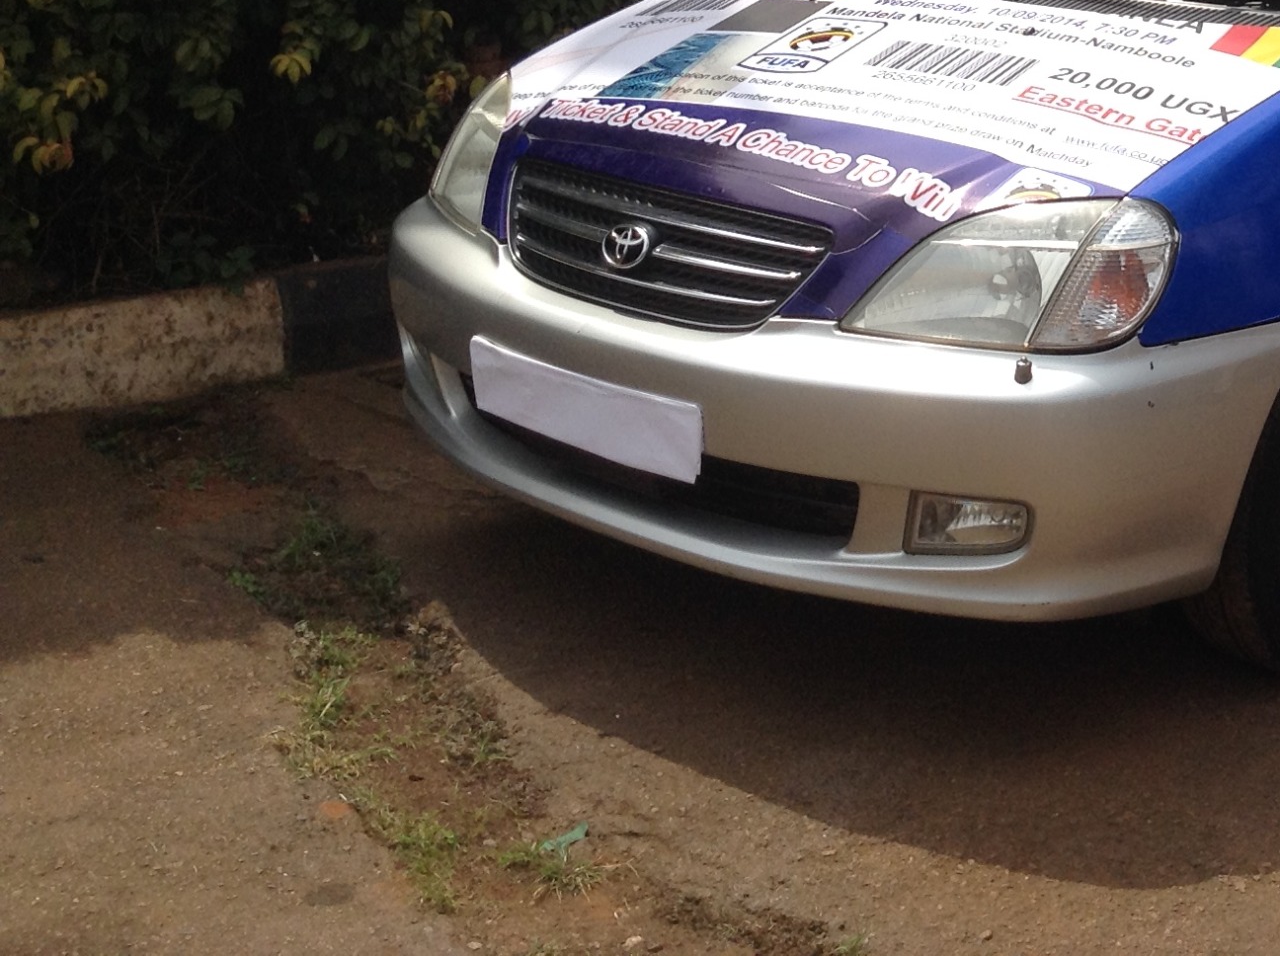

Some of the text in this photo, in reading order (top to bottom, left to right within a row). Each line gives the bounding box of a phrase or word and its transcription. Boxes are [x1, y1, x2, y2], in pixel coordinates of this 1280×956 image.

[825, 6, 904, 22] Mandela
[907, 12, 992, 30] National
[1094, 23, 1139, 39] 7:30
[1140, 32, 1178, 46] PM
[756, 56, 811, 69] FUFA
[1015, 85, 1136, 126] Eastern
[1048, 67, 1240, 123] 20,000 UGX
[540, 97, 623, 125] Ticket
[608, 104, 646, 127] &
[632, 108, 726, 143] Stand
[705, 122, 747, 146] A
[736, 129, 851, 173] Chance
[846, 154, 897, 187] To
[888, 167, 962, 221] Win
